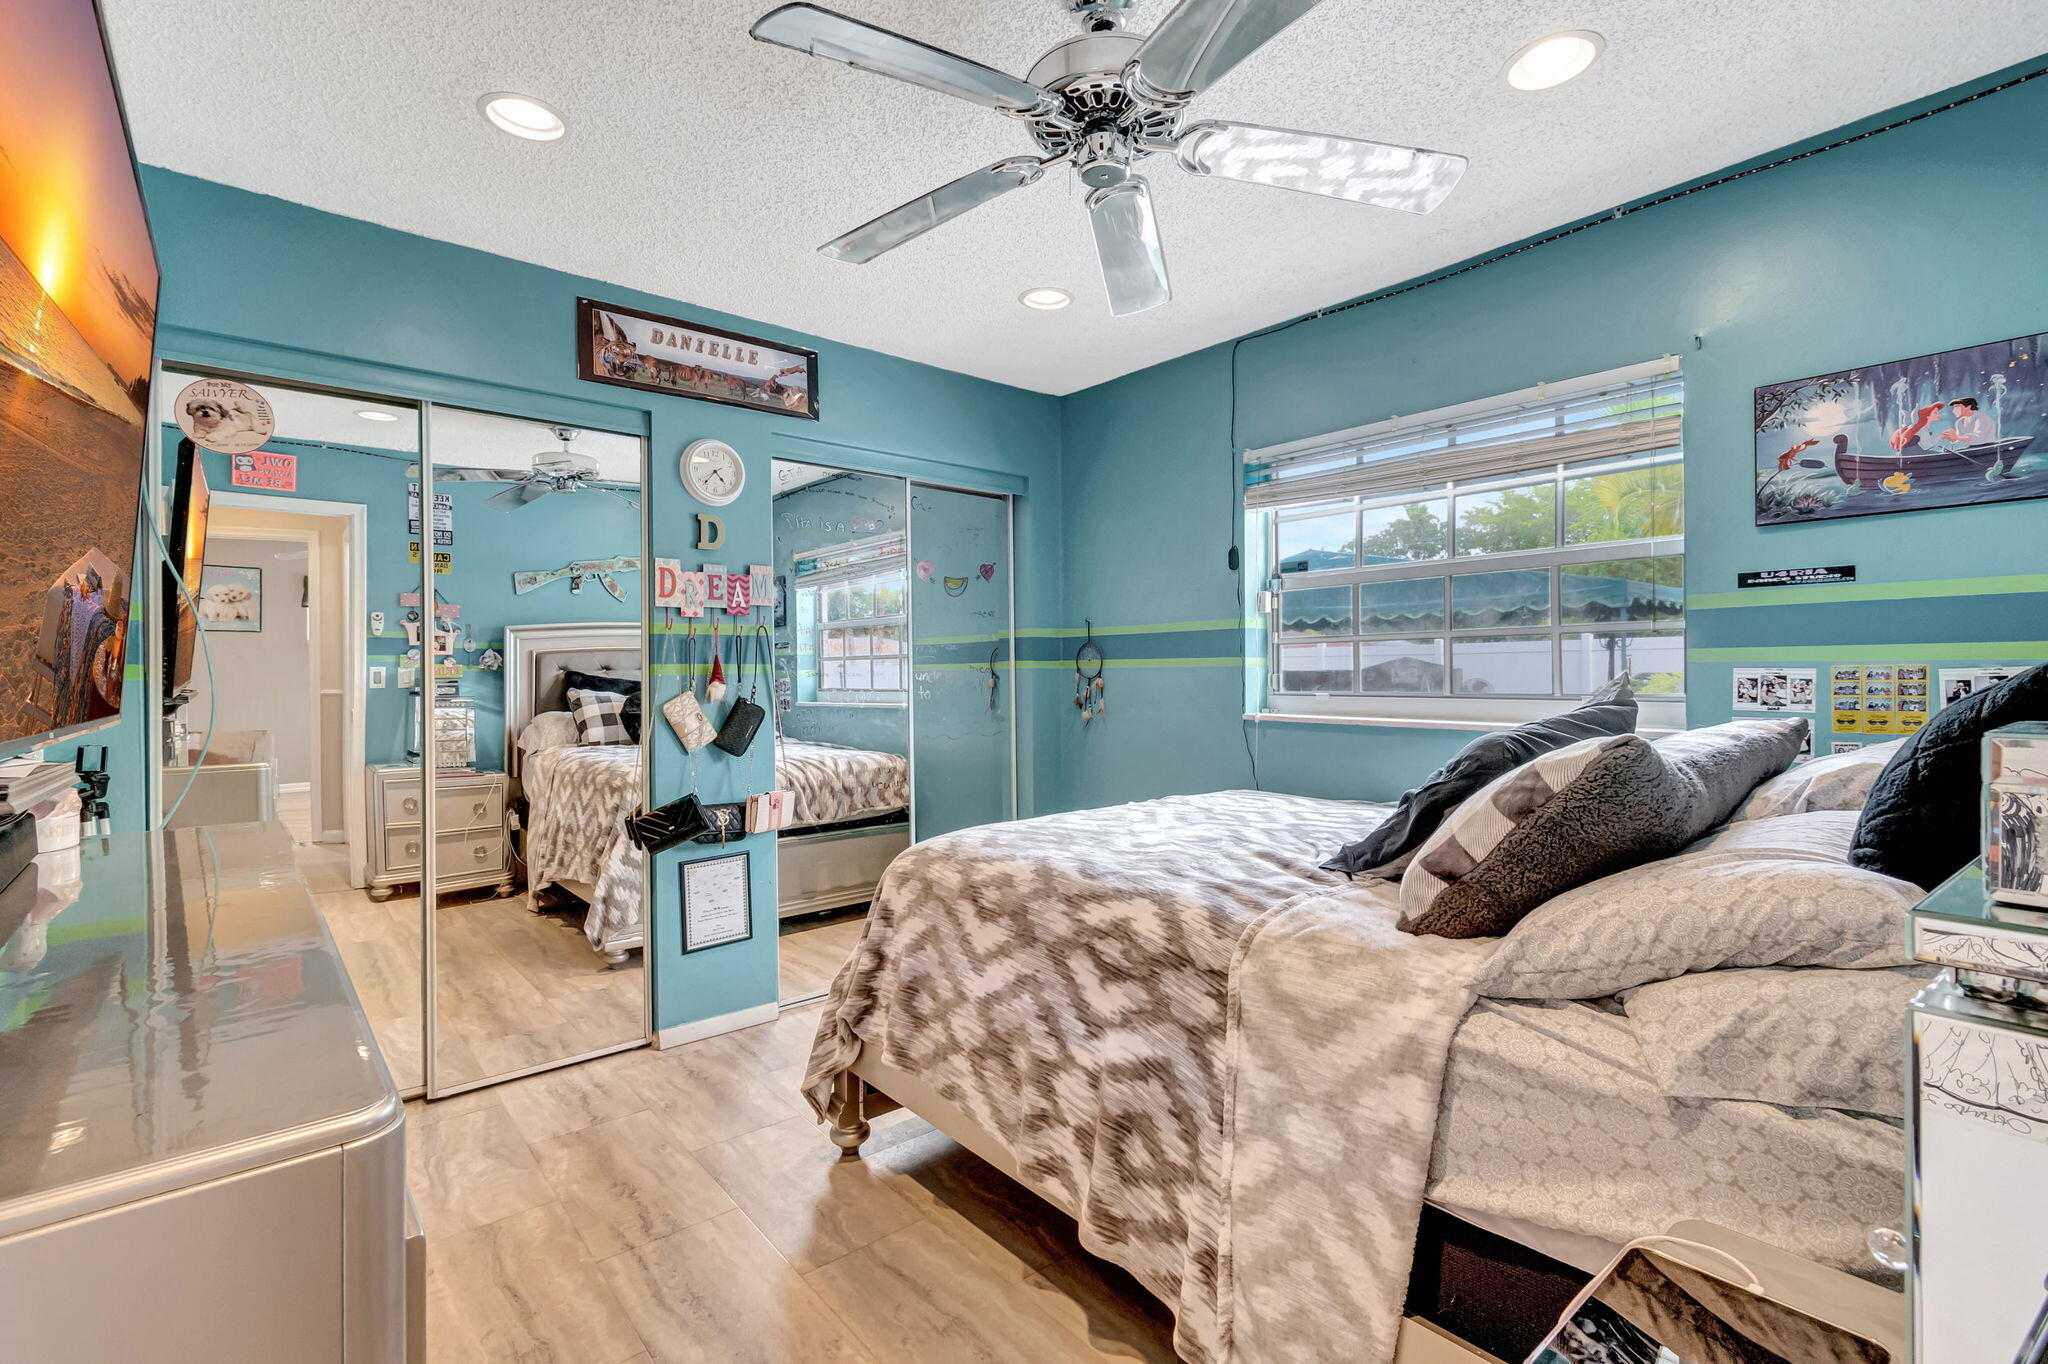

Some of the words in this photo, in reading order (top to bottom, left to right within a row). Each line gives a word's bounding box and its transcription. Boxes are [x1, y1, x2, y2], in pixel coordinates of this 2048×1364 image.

[649, 327, 760, 366] DANIELLE
[189, 388, 253, 401] SAWYER
[778, 467, 803, 482] GTA
[696, 513, 726, 550] D
[1760, 568, 1828, 578] U4RIA
[658, 567, 768, 609] DREAM
